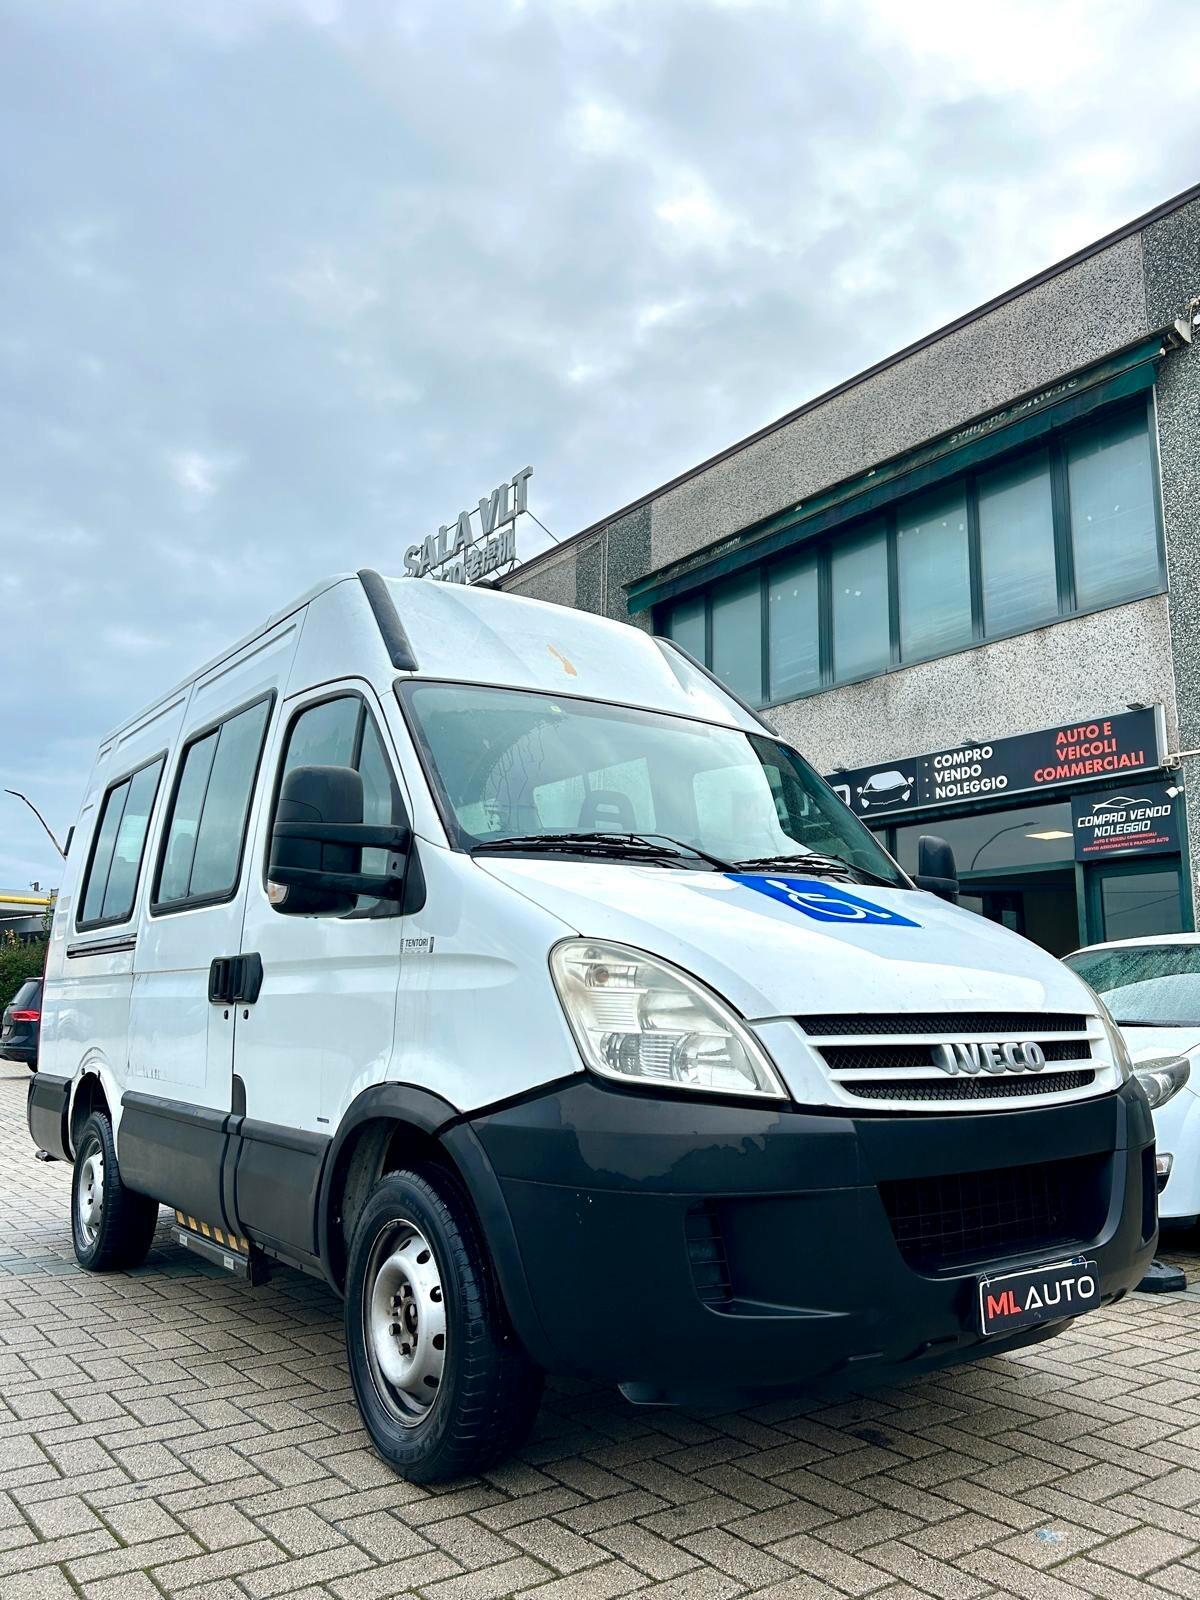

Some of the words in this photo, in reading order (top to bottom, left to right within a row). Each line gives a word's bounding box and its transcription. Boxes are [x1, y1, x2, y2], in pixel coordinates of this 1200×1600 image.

[403, 510, 474, 577] SALA
[478, 465, 533, 536] VLT
[1055, 724, 1099, 745] AUTO
[1103, 721, 1112, 736] E
[934, 746, 993, 768] COMPRO
[1056, 738, 1117, 761] VEICOLI
[934, 764, 982, 783] VENDO
[1034, 750, 1145, 782] COMMERCIALI
[935, 775, 1008, 799] NOLEGGIO
[1077, 811, 1126, 828] COMPRO
[1129, 804, 1171, 820] VENDO
[1094, 820, 1151, 838] NOLEGGIO
[405, 938, 429, 947] TENTORI
[936, 1041, 1046, 1075] IVECO
[987, 1290, 1022, 1319] ML
[1024, 1275, 1095, 1311] AUTO
